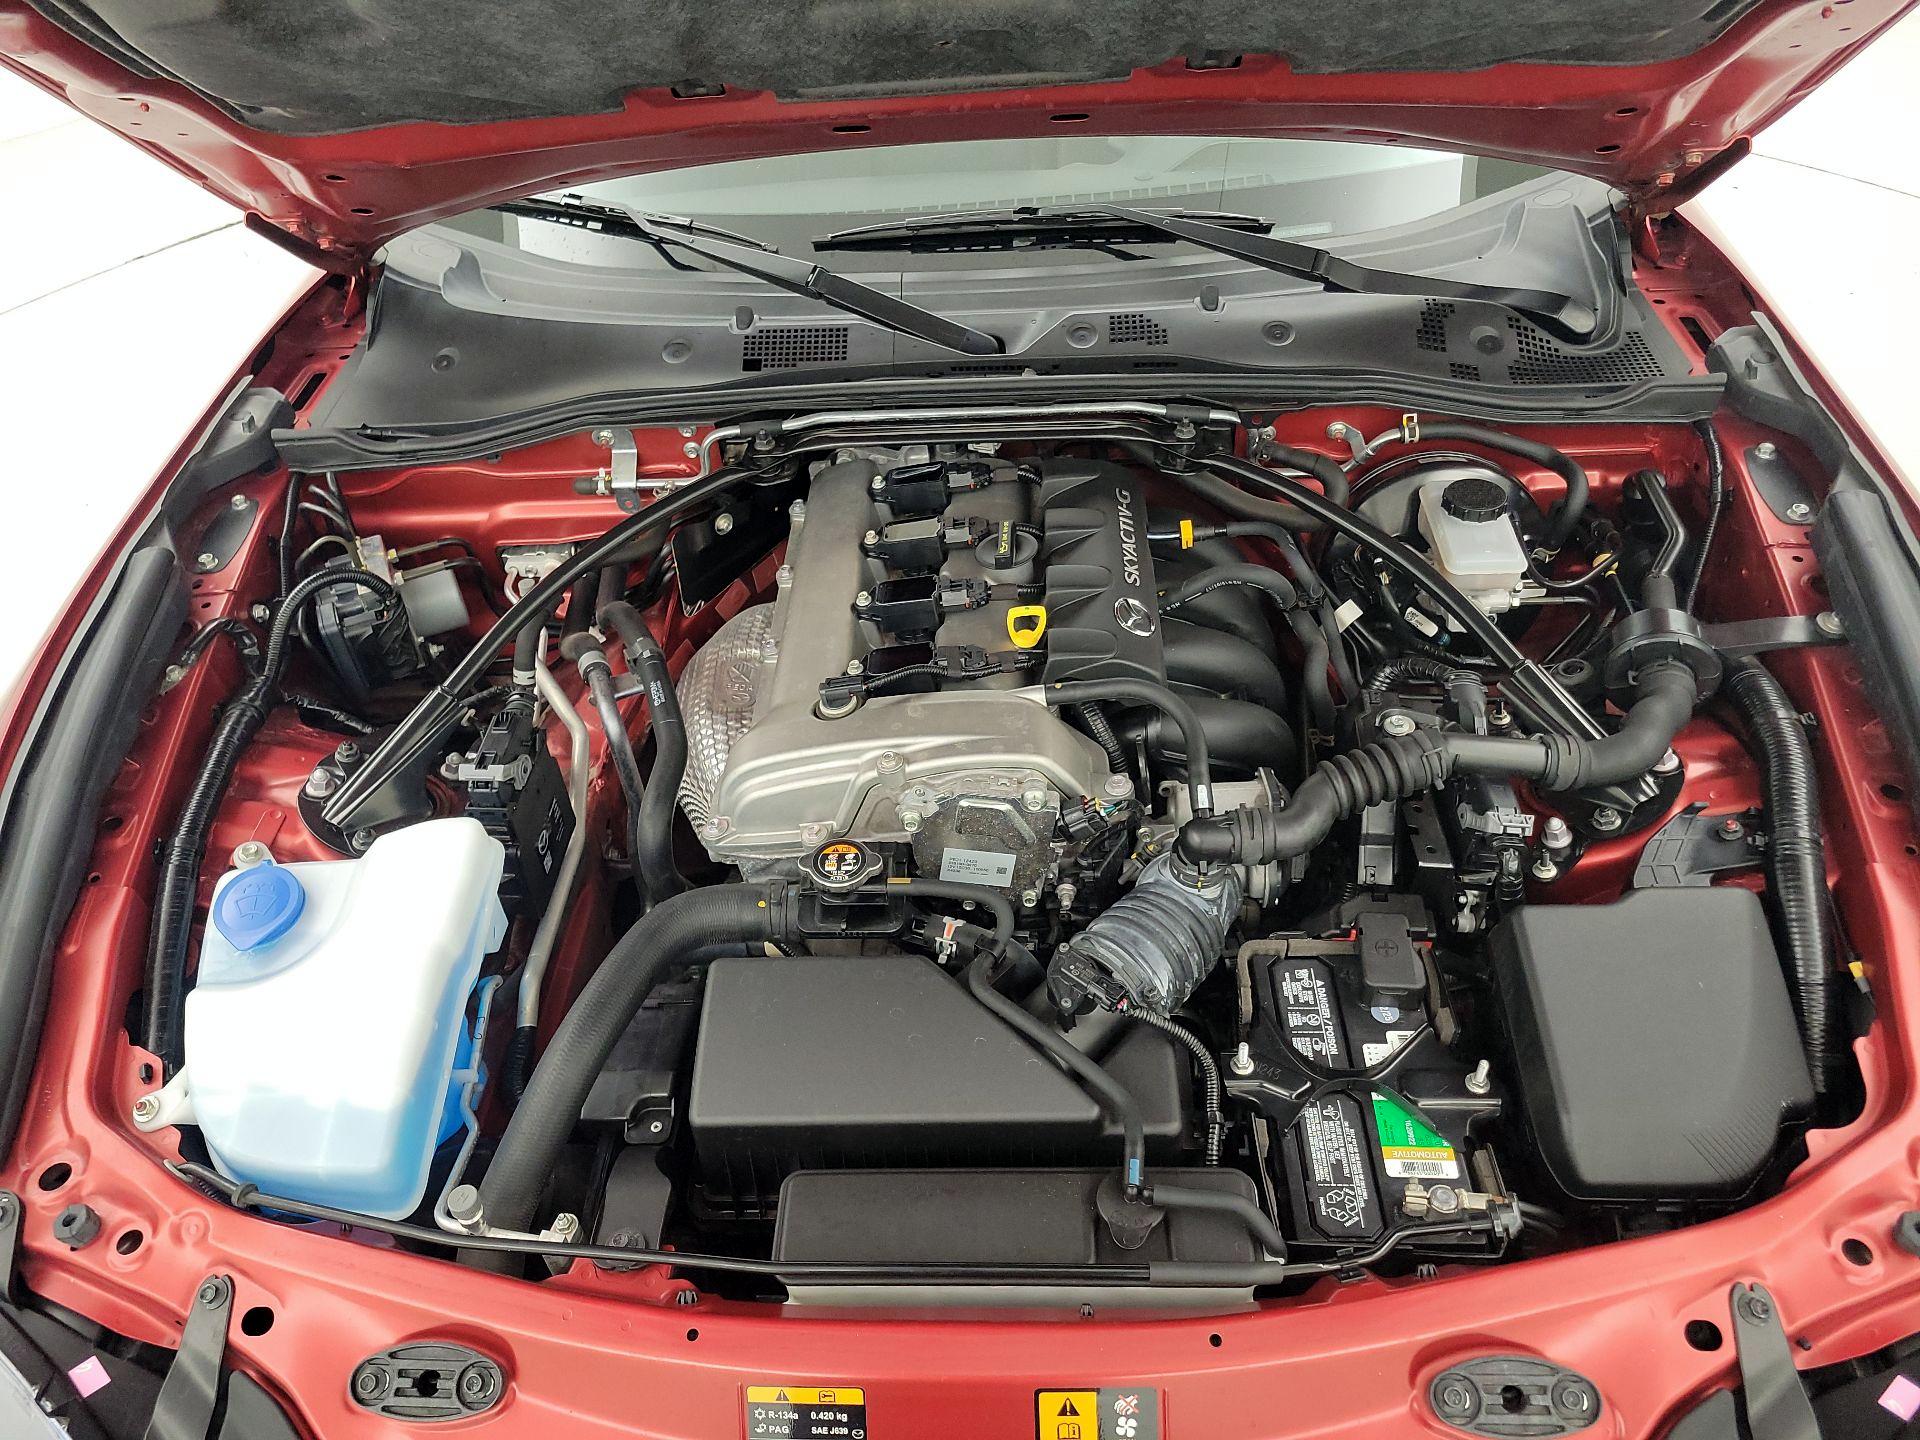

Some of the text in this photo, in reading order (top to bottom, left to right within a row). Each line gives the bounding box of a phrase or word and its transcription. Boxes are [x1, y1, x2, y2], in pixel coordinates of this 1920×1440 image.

[1116, 487, 1140, 587] SKYACTIV-G
[1391, 1150, 1448, 1159] AUTOMOTIVE
[768, 1411, 848, 1422] R-134a 0.420 kg
[768, 1425, 849, 1435] PAG SAE J639
